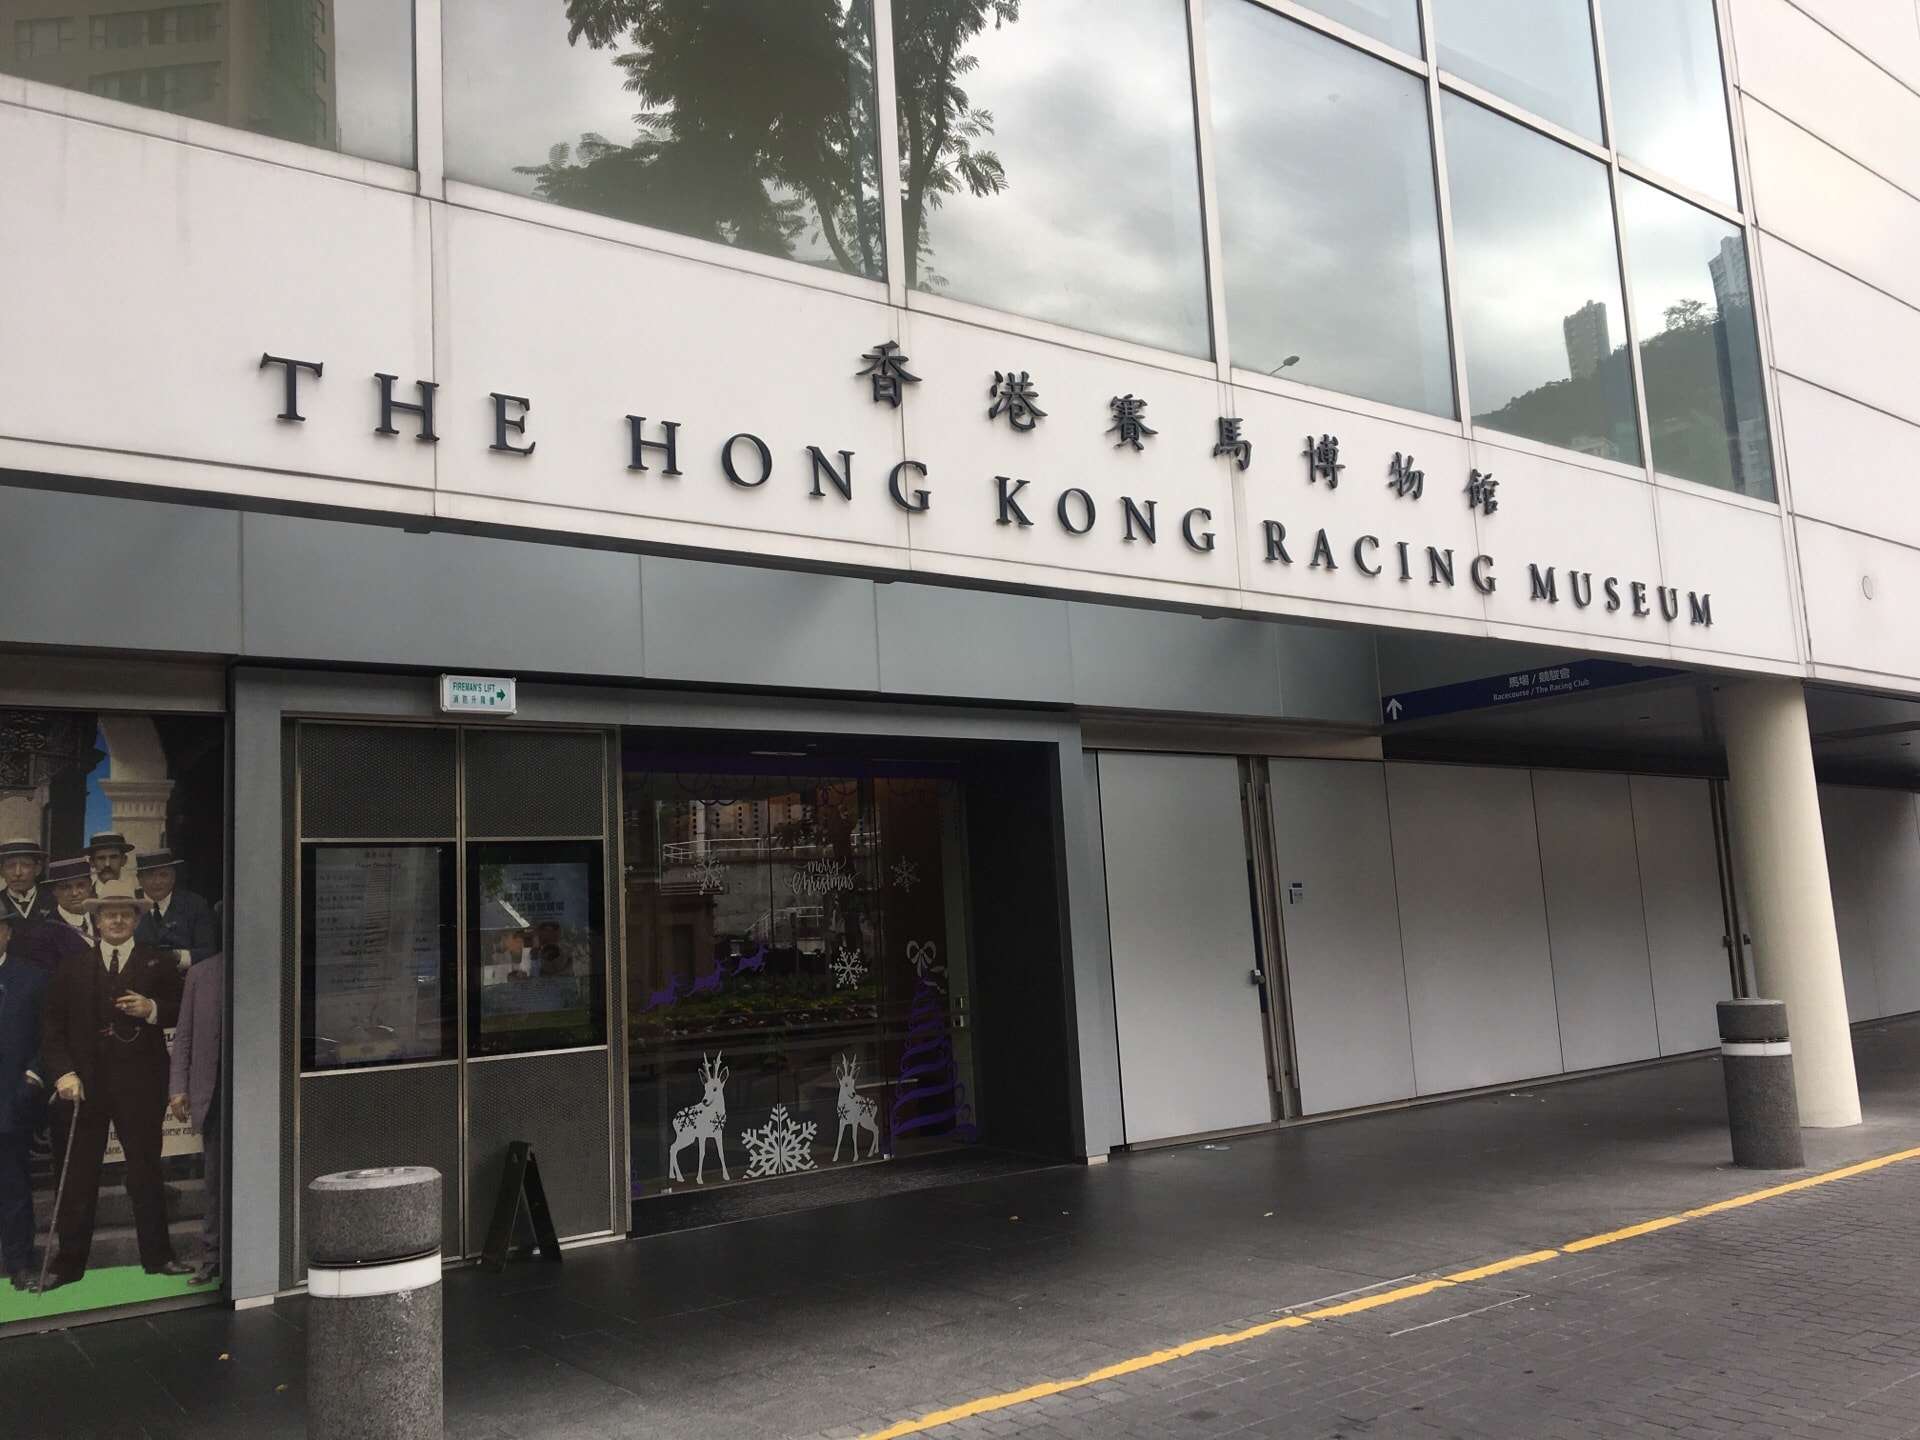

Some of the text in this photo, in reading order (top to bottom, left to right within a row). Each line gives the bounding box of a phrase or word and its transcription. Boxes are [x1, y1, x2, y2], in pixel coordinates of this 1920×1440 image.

[856, 339, 1500, 516] 香港賽馬博物館
[260, 352, 1713, 627] THE HONG KONG RACING MUSEUM
[452, 682, 496, 693] FIREMAN'S LIFT
[1493, 689, 1530, 701] Racecourse
[1536, 685, 1549, 695] The
[1549, 682, 1573, 692] Racing
[1573, 678, 1590, 688] Club
[790, 871, 860, 897] Christmas
